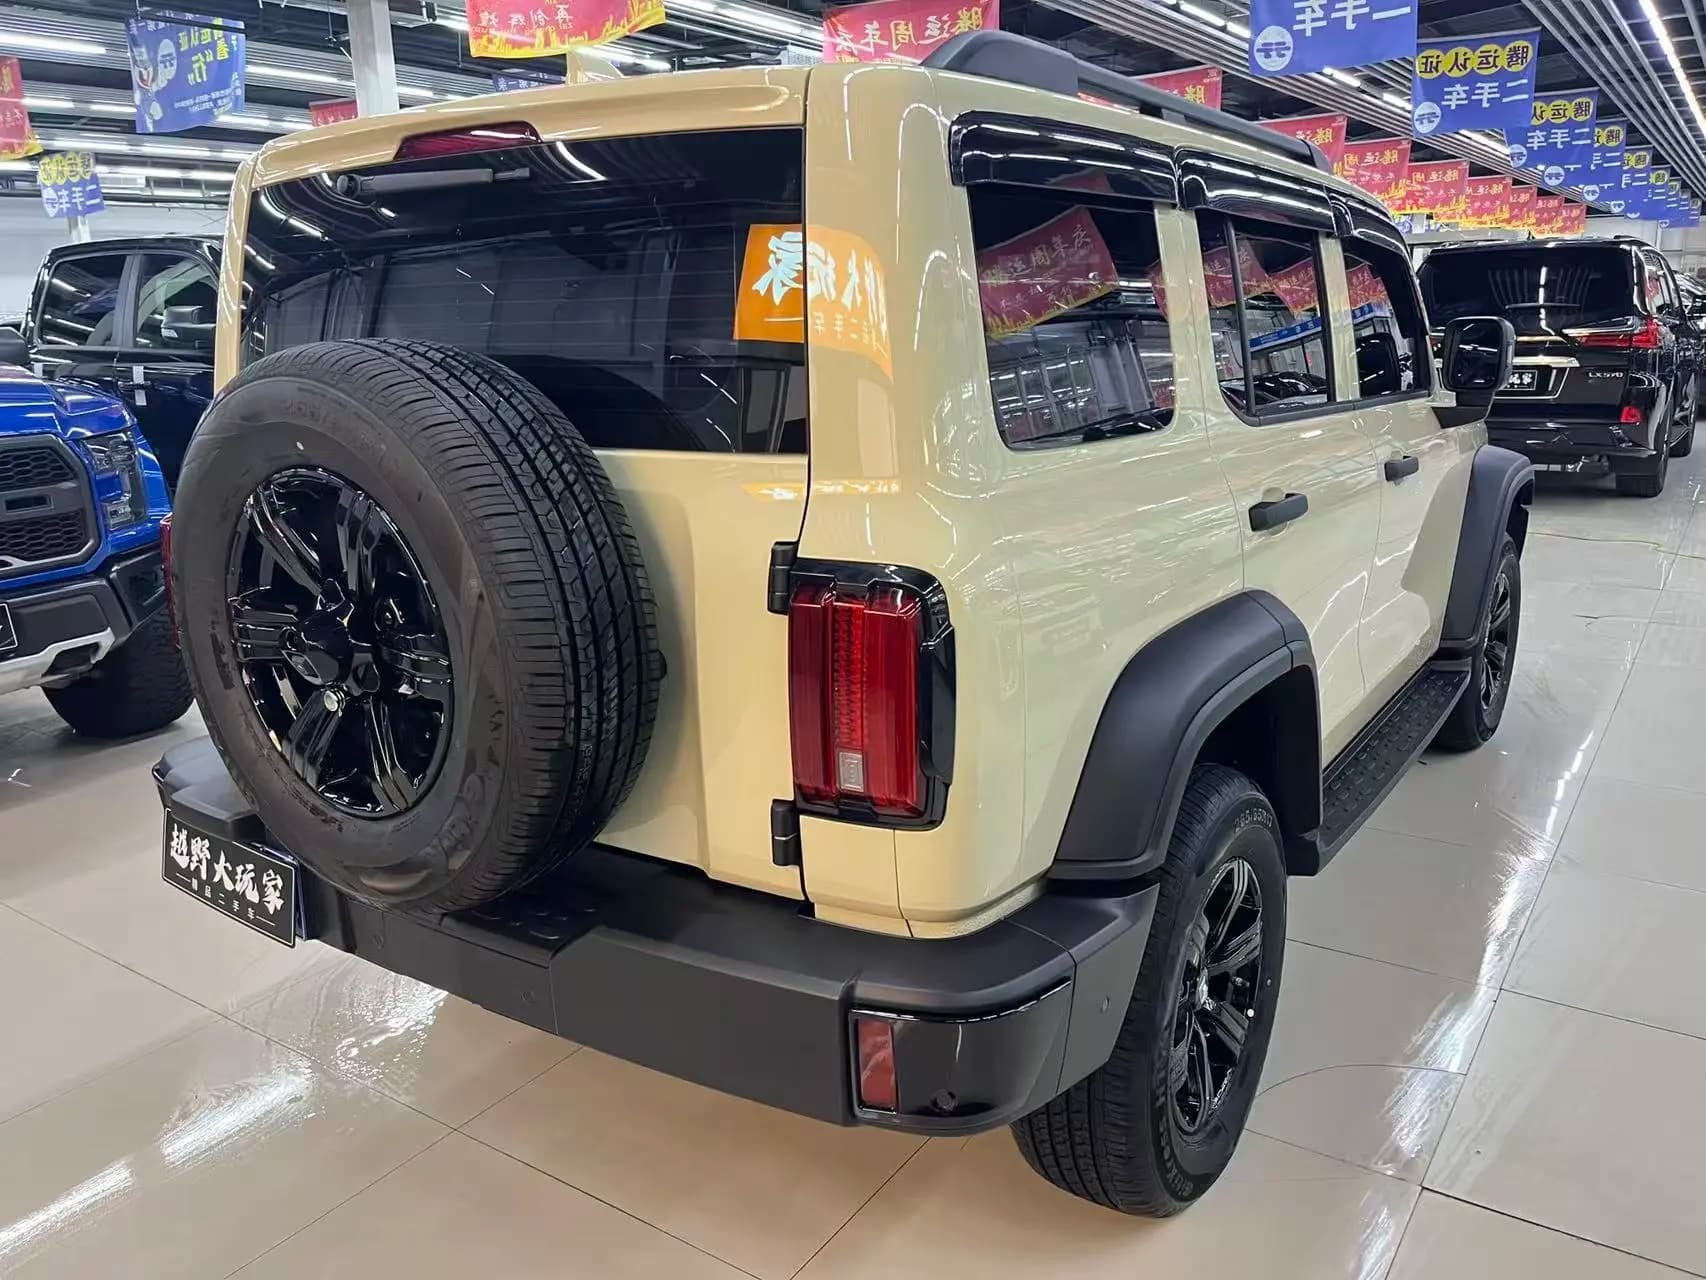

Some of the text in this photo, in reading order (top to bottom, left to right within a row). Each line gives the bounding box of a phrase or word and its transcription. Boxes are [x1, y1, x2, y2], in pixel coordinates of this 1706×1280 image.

[170, 823, 285, 915] 越野大玩家
